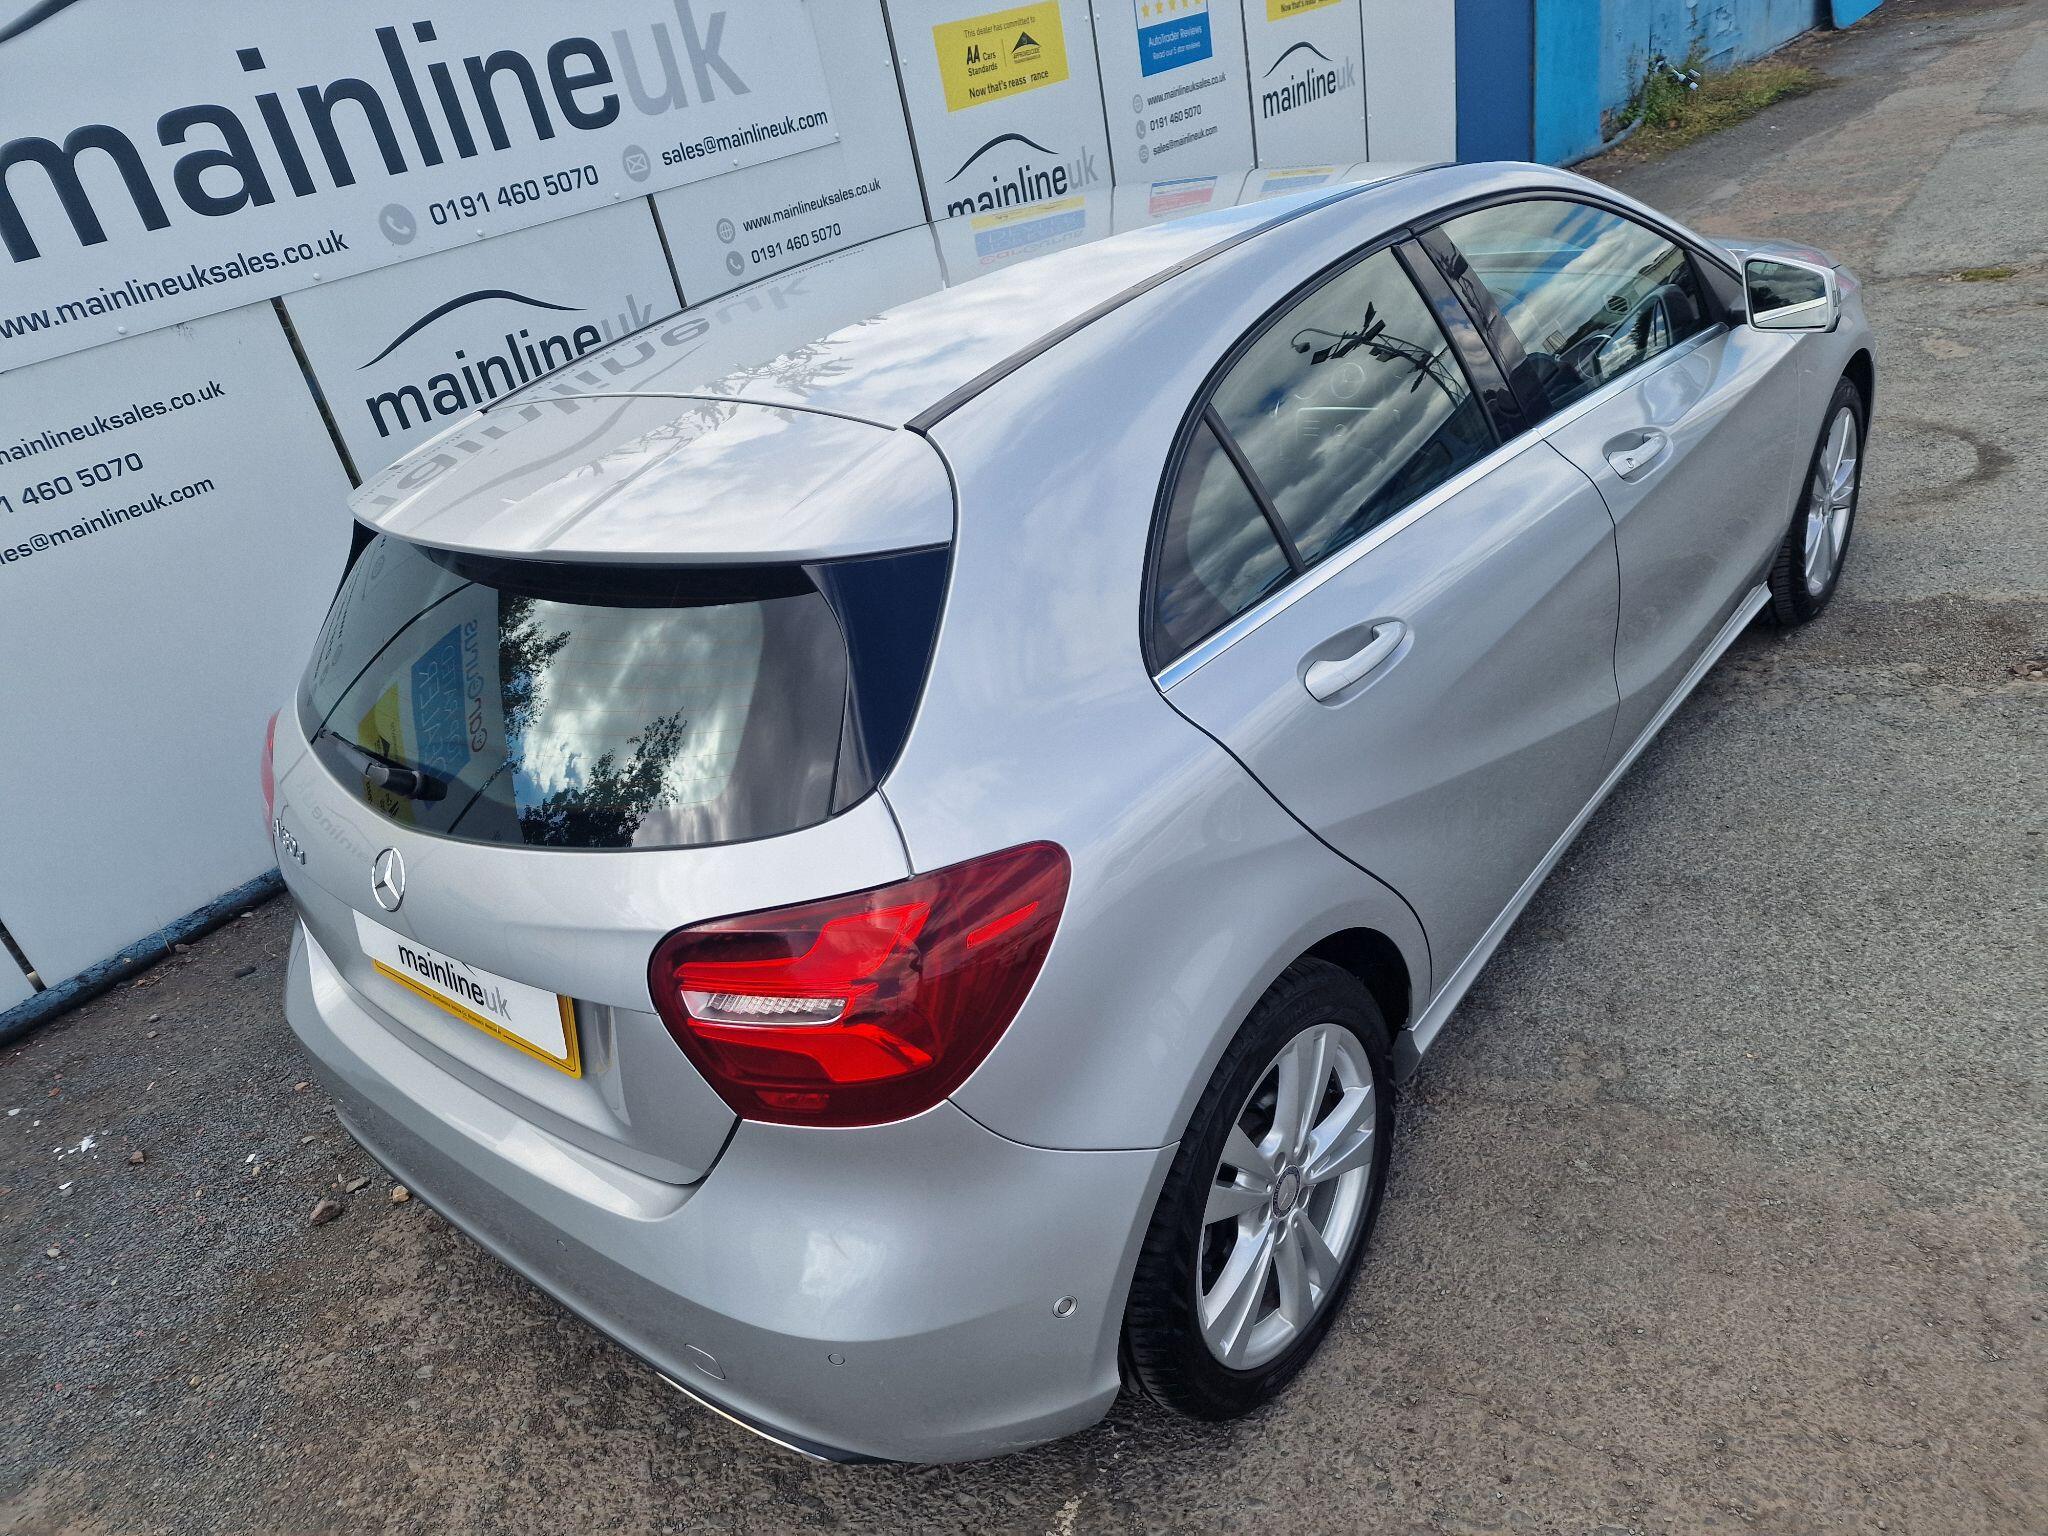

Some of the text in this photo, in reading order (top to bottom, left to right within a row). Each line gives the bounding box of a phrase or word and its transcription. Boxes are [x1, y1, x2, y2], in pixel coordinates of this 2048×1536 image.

[966, 44, 980, 65] AA
[982, 51, 996, 61] Cars
[968, 62, 998, 77] Standards
[969, 85, 986, 99] Now
[987, 79, 1007, 95] that's
[1147, 72, 1226, 106] www.mainlineuksales.co.uk
[1262, 56, 1356, 119] mainlineuk
[0, 0, 752, 263] mainlineuk
[661, 111, 829, 166] sales@mainlineuk.com
[1149, 104, 1202, 131] 0191 460 5070
[1153, 125, 1218, 156] sales@mainlineuk.com
[428, 164, 599, 226] 0191 460 5070
[742, 177, 882, 232] www.mainlineuksales.co.uk
[947, 146, 1099, 218] mainlineuk
[751, 222, 842, 264] 0191 460 5070
[22, 476, 73, 505] 460
[75, 452, 144, 488] 5070
[398, 944, 512, 1022] mainlineuk
